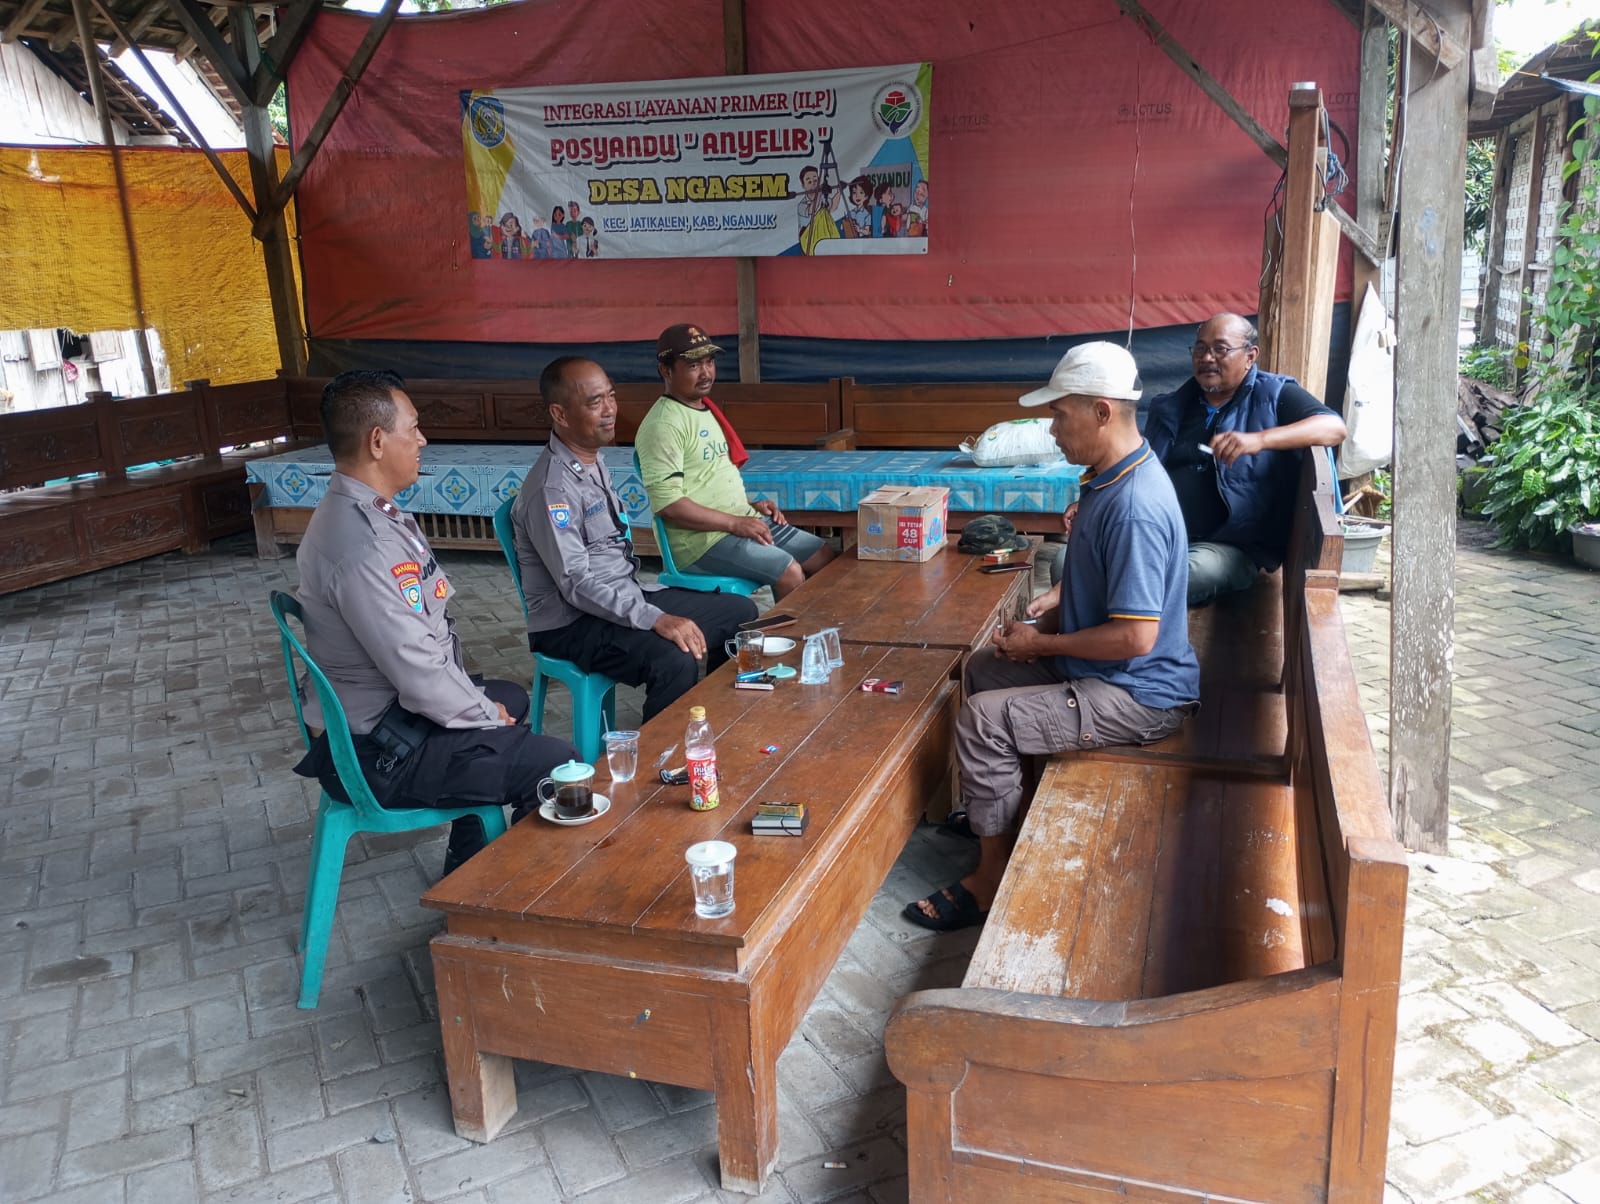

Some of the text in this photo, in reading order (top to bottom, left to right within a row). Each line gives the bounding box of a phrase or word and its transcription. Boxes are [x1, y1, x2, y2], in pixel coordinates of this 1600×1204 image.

[543, 88, 832, 121] INTEGRASI LAYANAN PRIMER (ILP)
[550, 133, 677, 164] POSYANDU
[588, 174, 788, 203] DESA NGASEM
[863, 171, 911, 189] SYANDU
[602, 217, 626, 231] KEC.
[722, 213, 775, 229] NGANJUK
[901, 528, 918, 538] 48
